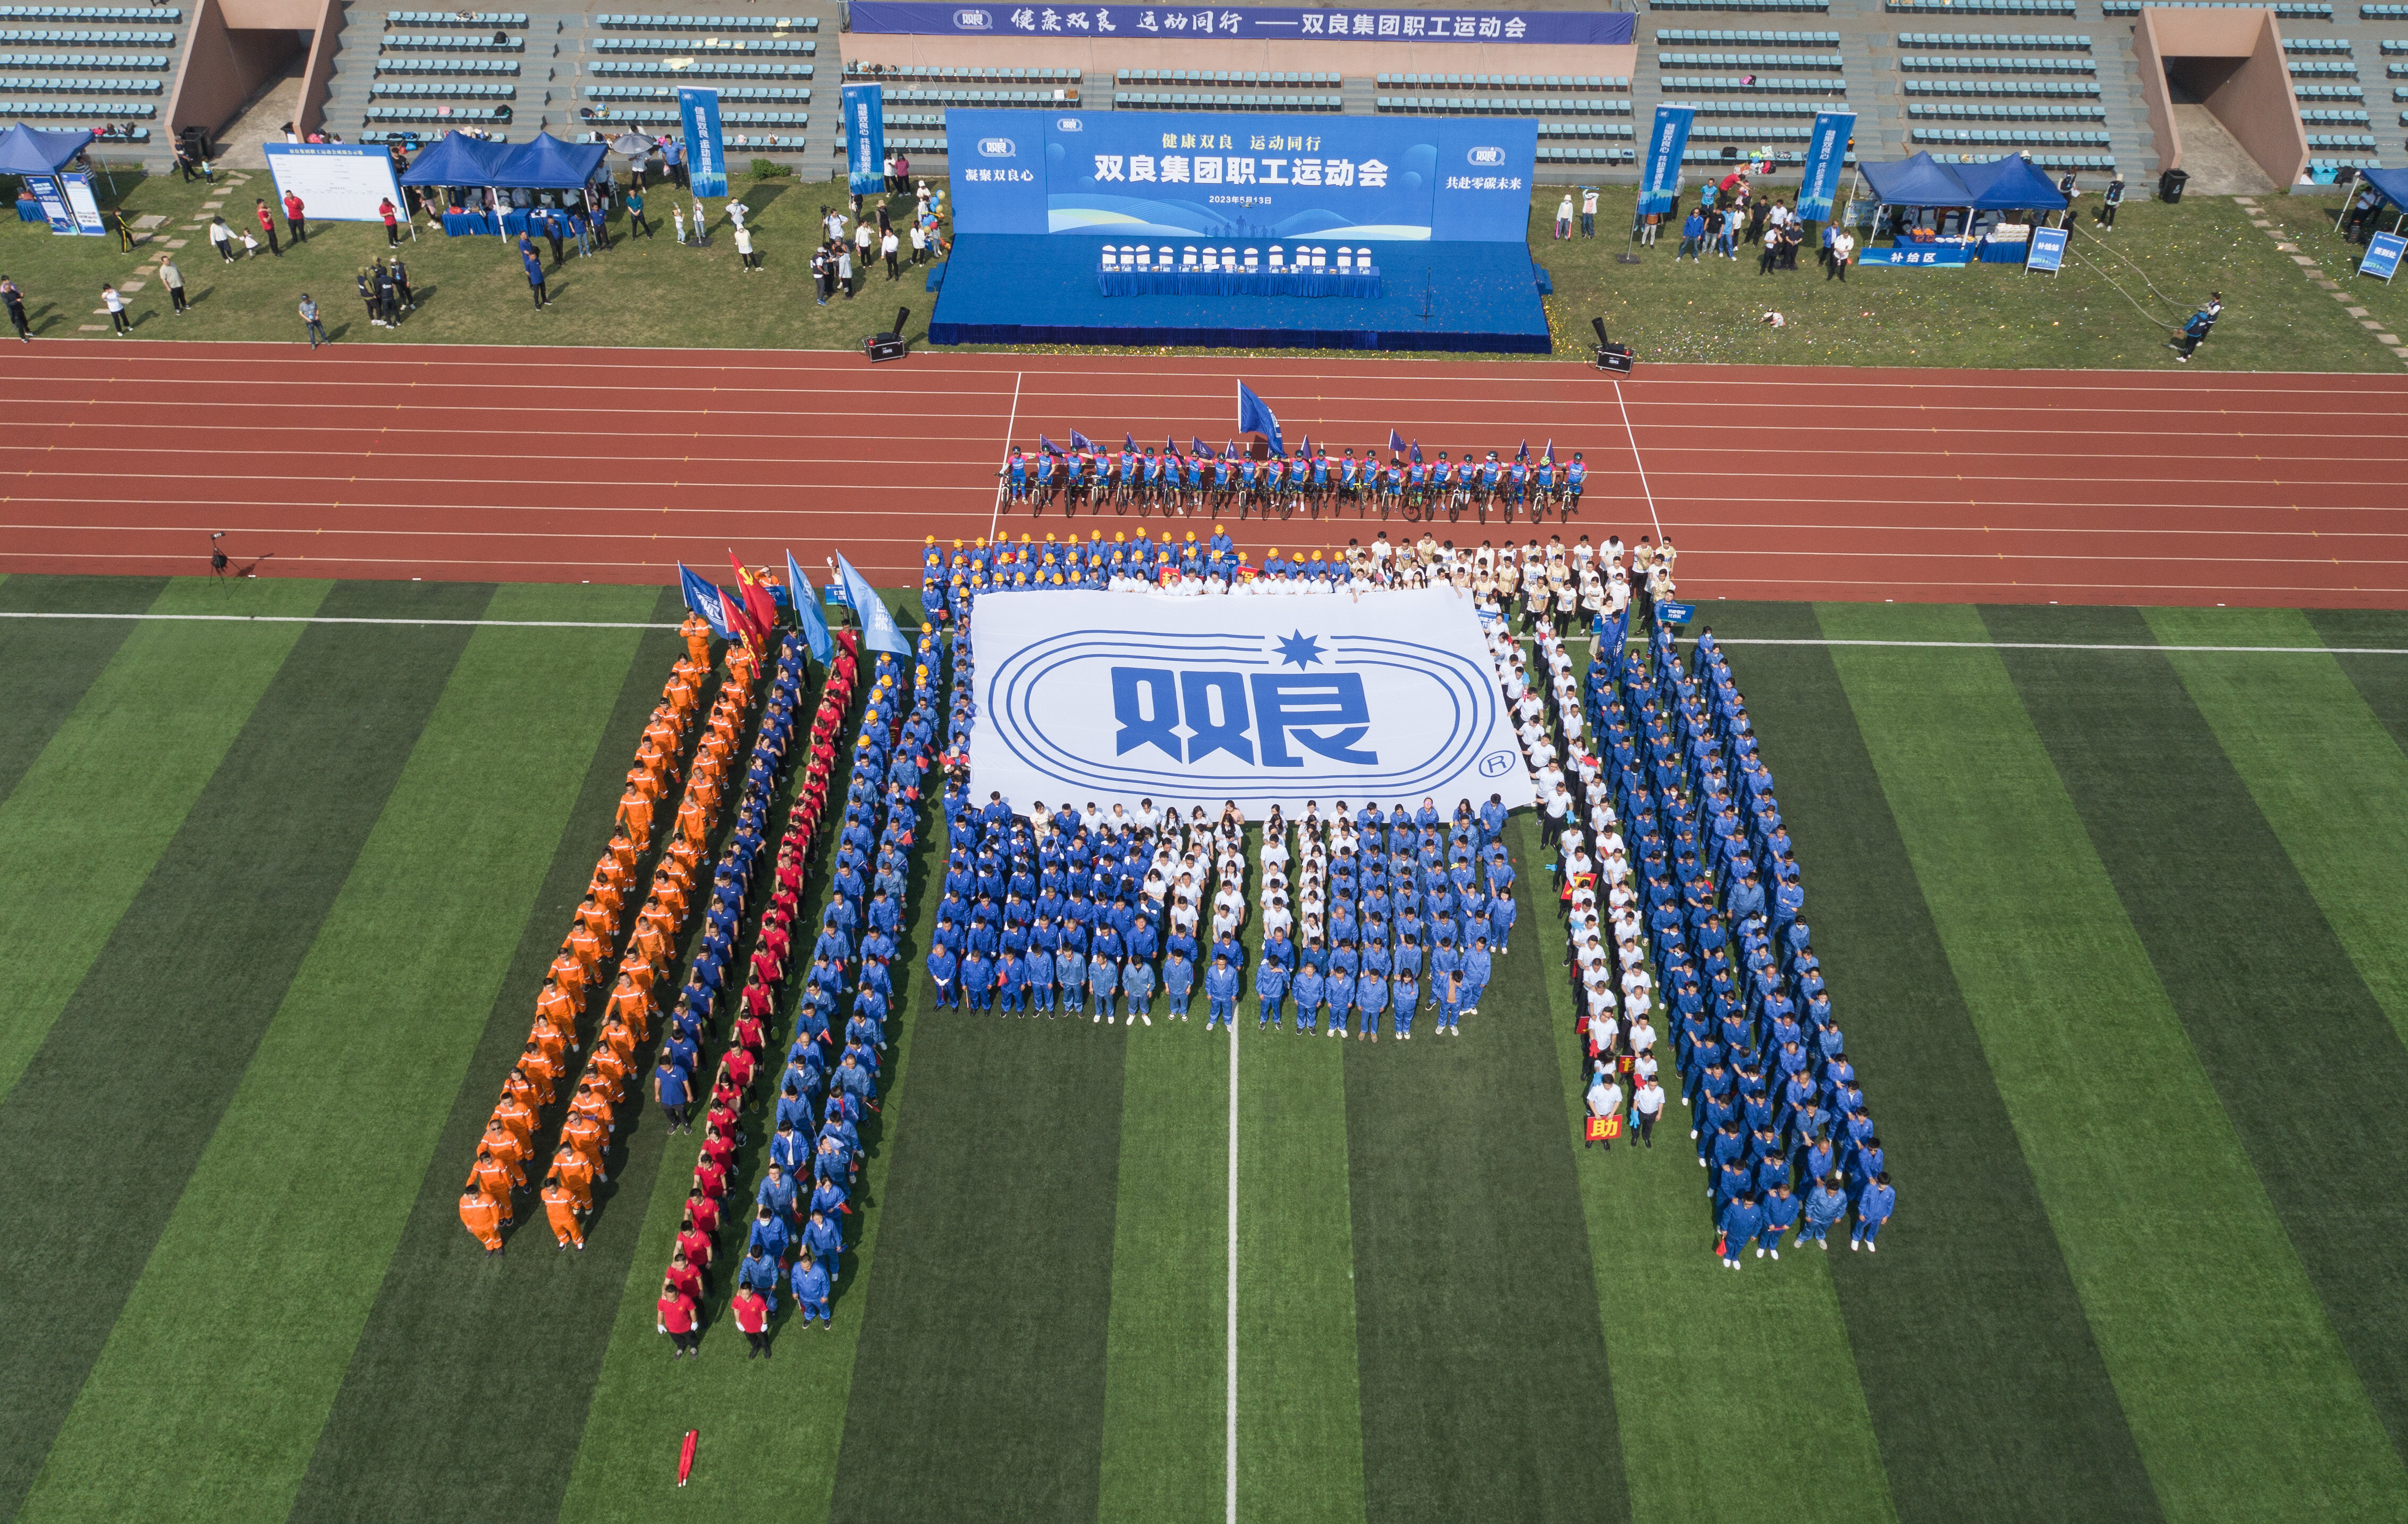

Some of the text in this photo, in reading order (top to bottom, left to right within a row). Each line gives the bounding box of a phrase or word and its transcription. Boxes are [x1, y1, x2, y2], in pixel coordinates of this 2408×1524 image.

[962, 14, 983, 26] 双良
[1011, 8, 1116, 31] 健康双良
[1136, 11, 1243, 33] 运动同行
[986, 142, 1007, 153] 双良
[1162, 133, 1321, 151] 健康双良 运动同行
[1476, 150, 1497, 162] 双良
[965, 168, 1034, 182] 凝聚双良心
[1094, 154, 1389, 188] 双良集团职工运动会
[1446, 176, 1522, 190] 共赴零碳未来
[1209, 196, 1272, 205] 2023年5月13日
[1891, 252, 1937, 263] 补给区
[1111, 666, 1379, 767] 双良
[1591, 1119, 1618, 1137] 助
